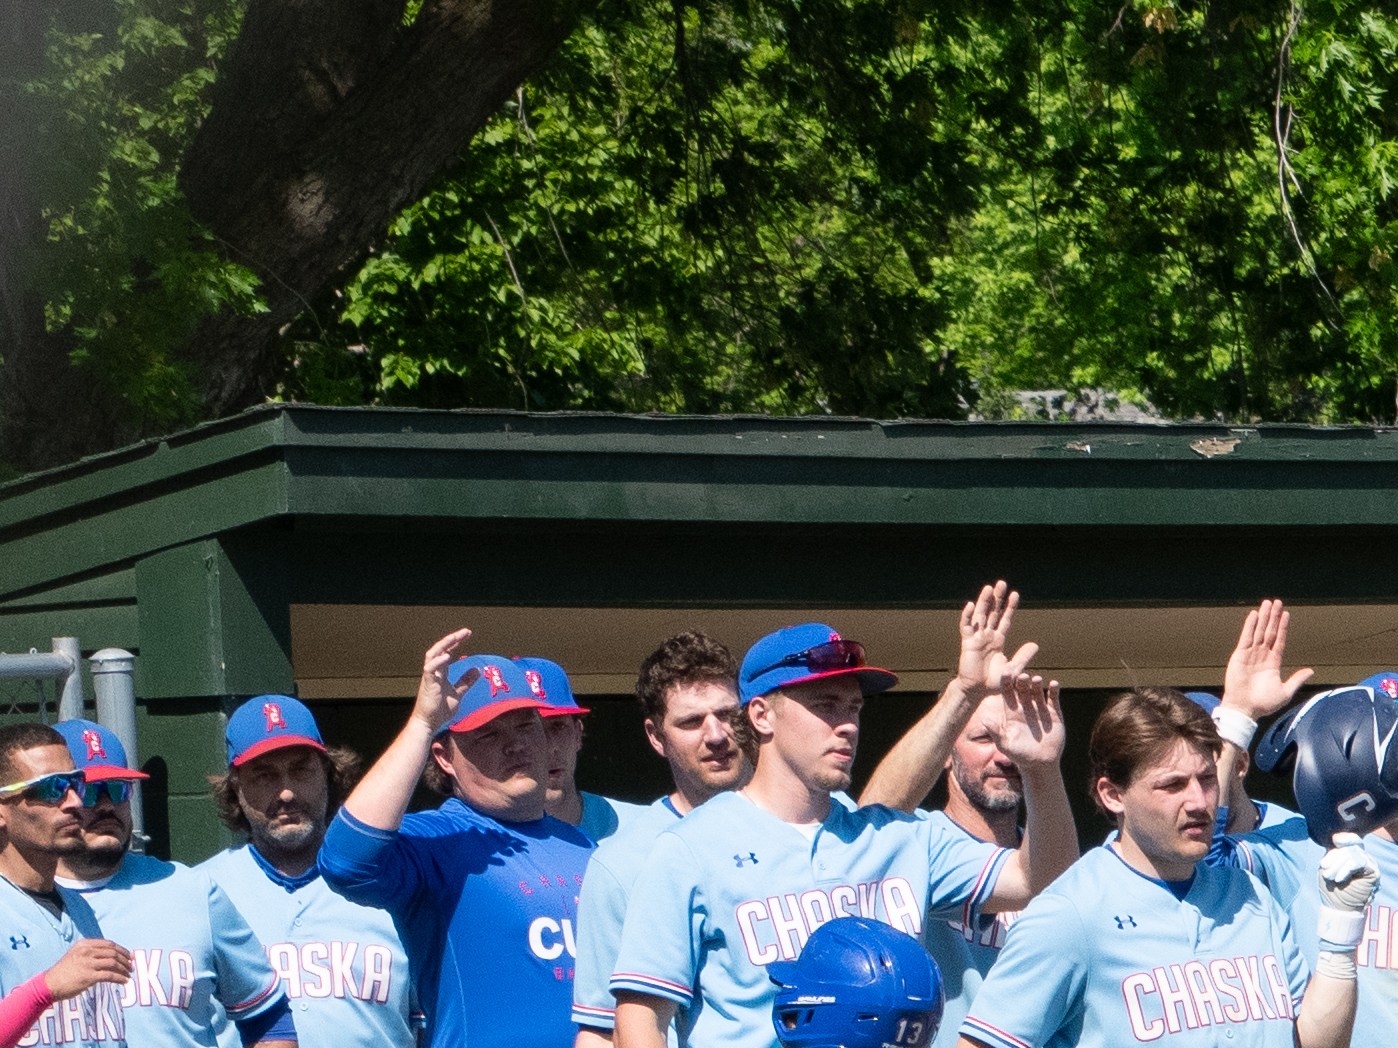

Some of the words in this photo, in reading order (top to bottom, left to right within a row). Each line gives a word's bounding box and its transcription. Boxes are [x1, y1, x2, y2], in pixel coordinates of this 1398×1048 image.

[1337, 790, 1376, 822] C
[1121, 955, 1294, 1042] CHASKA
[895, 1019, 923, 1044] 13
